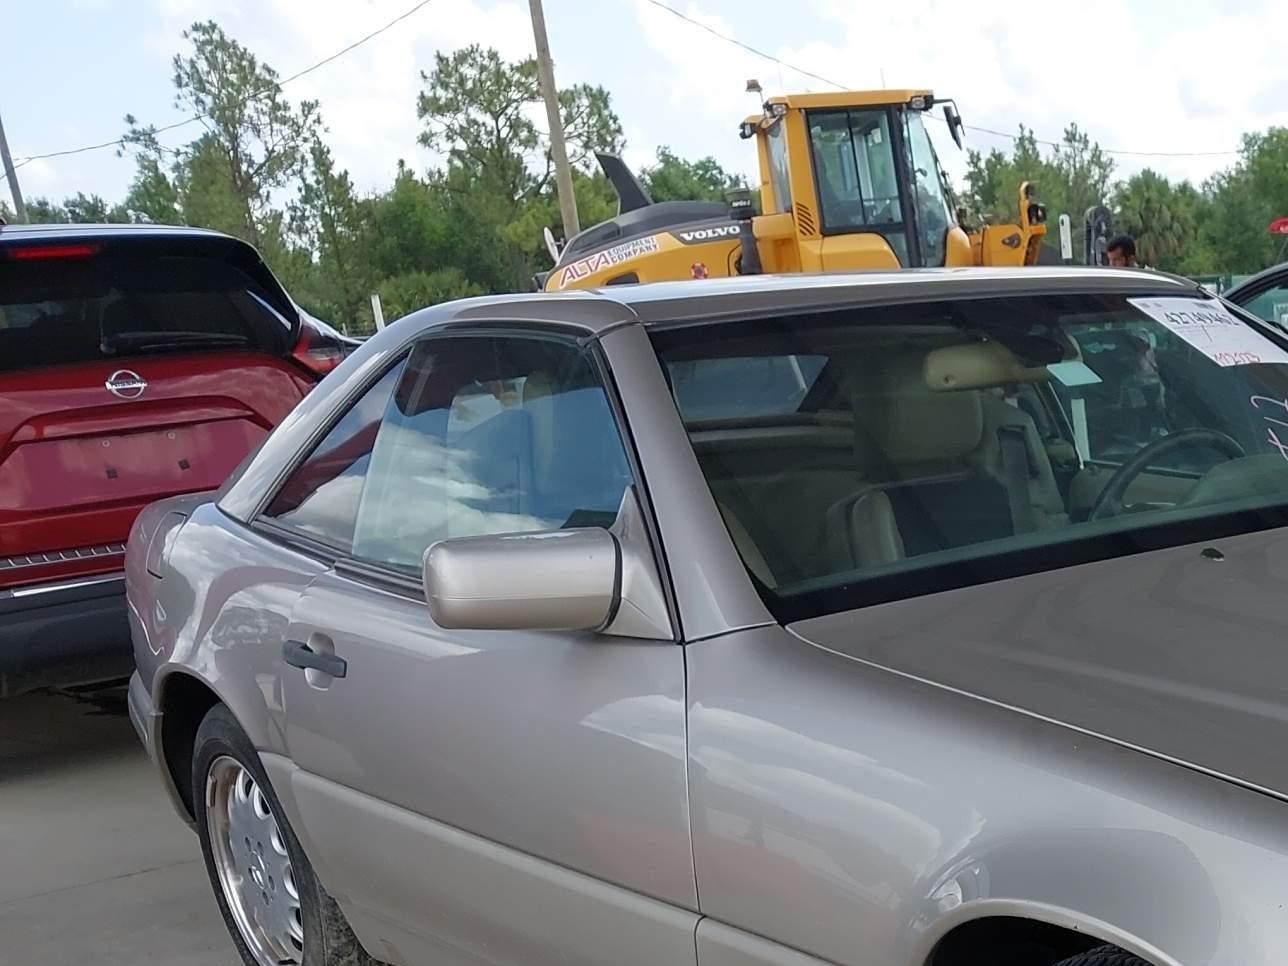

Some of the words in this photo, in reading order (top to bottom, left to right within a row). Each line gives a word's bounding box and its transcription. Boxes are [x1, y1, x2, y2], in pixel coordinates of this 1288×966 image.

[680, 225, 741, 241] VOLVO
[611, 244, 659, 263] COMPANY
[561, 253, 611, 286] ALTA
